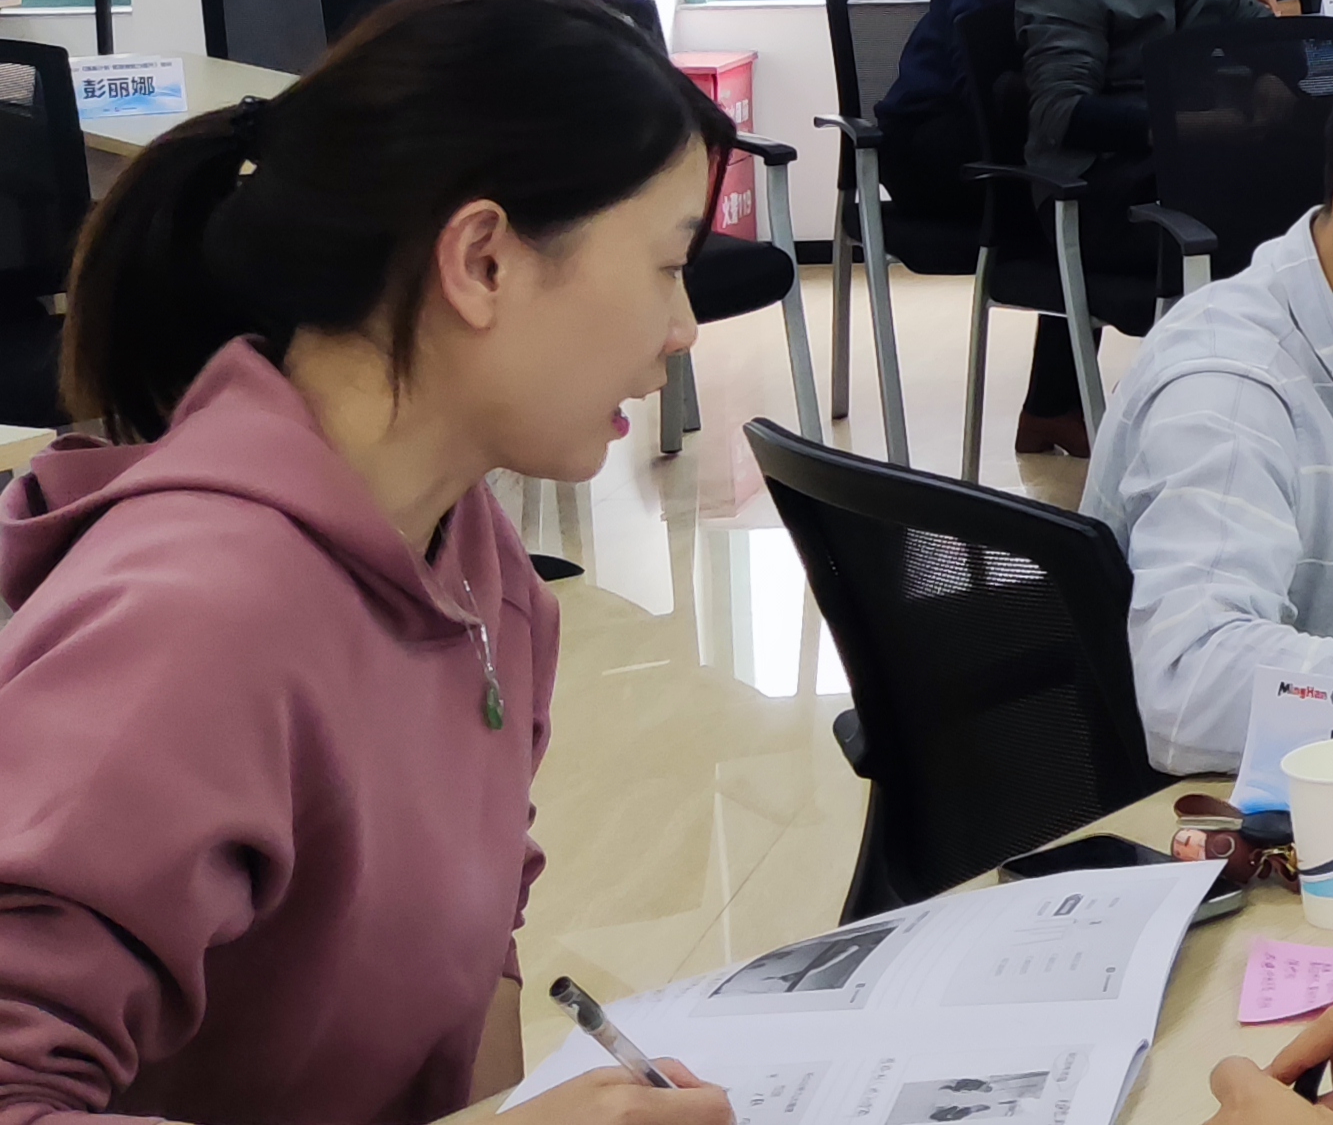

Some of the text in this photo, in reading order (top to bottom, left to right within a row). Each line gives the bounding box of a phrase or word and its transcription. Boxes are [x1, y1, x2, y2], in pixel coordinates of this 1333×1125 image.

[82, 76, 155, 99] 彭丽娜
[1278, 681, 1328, 700] MingHan
